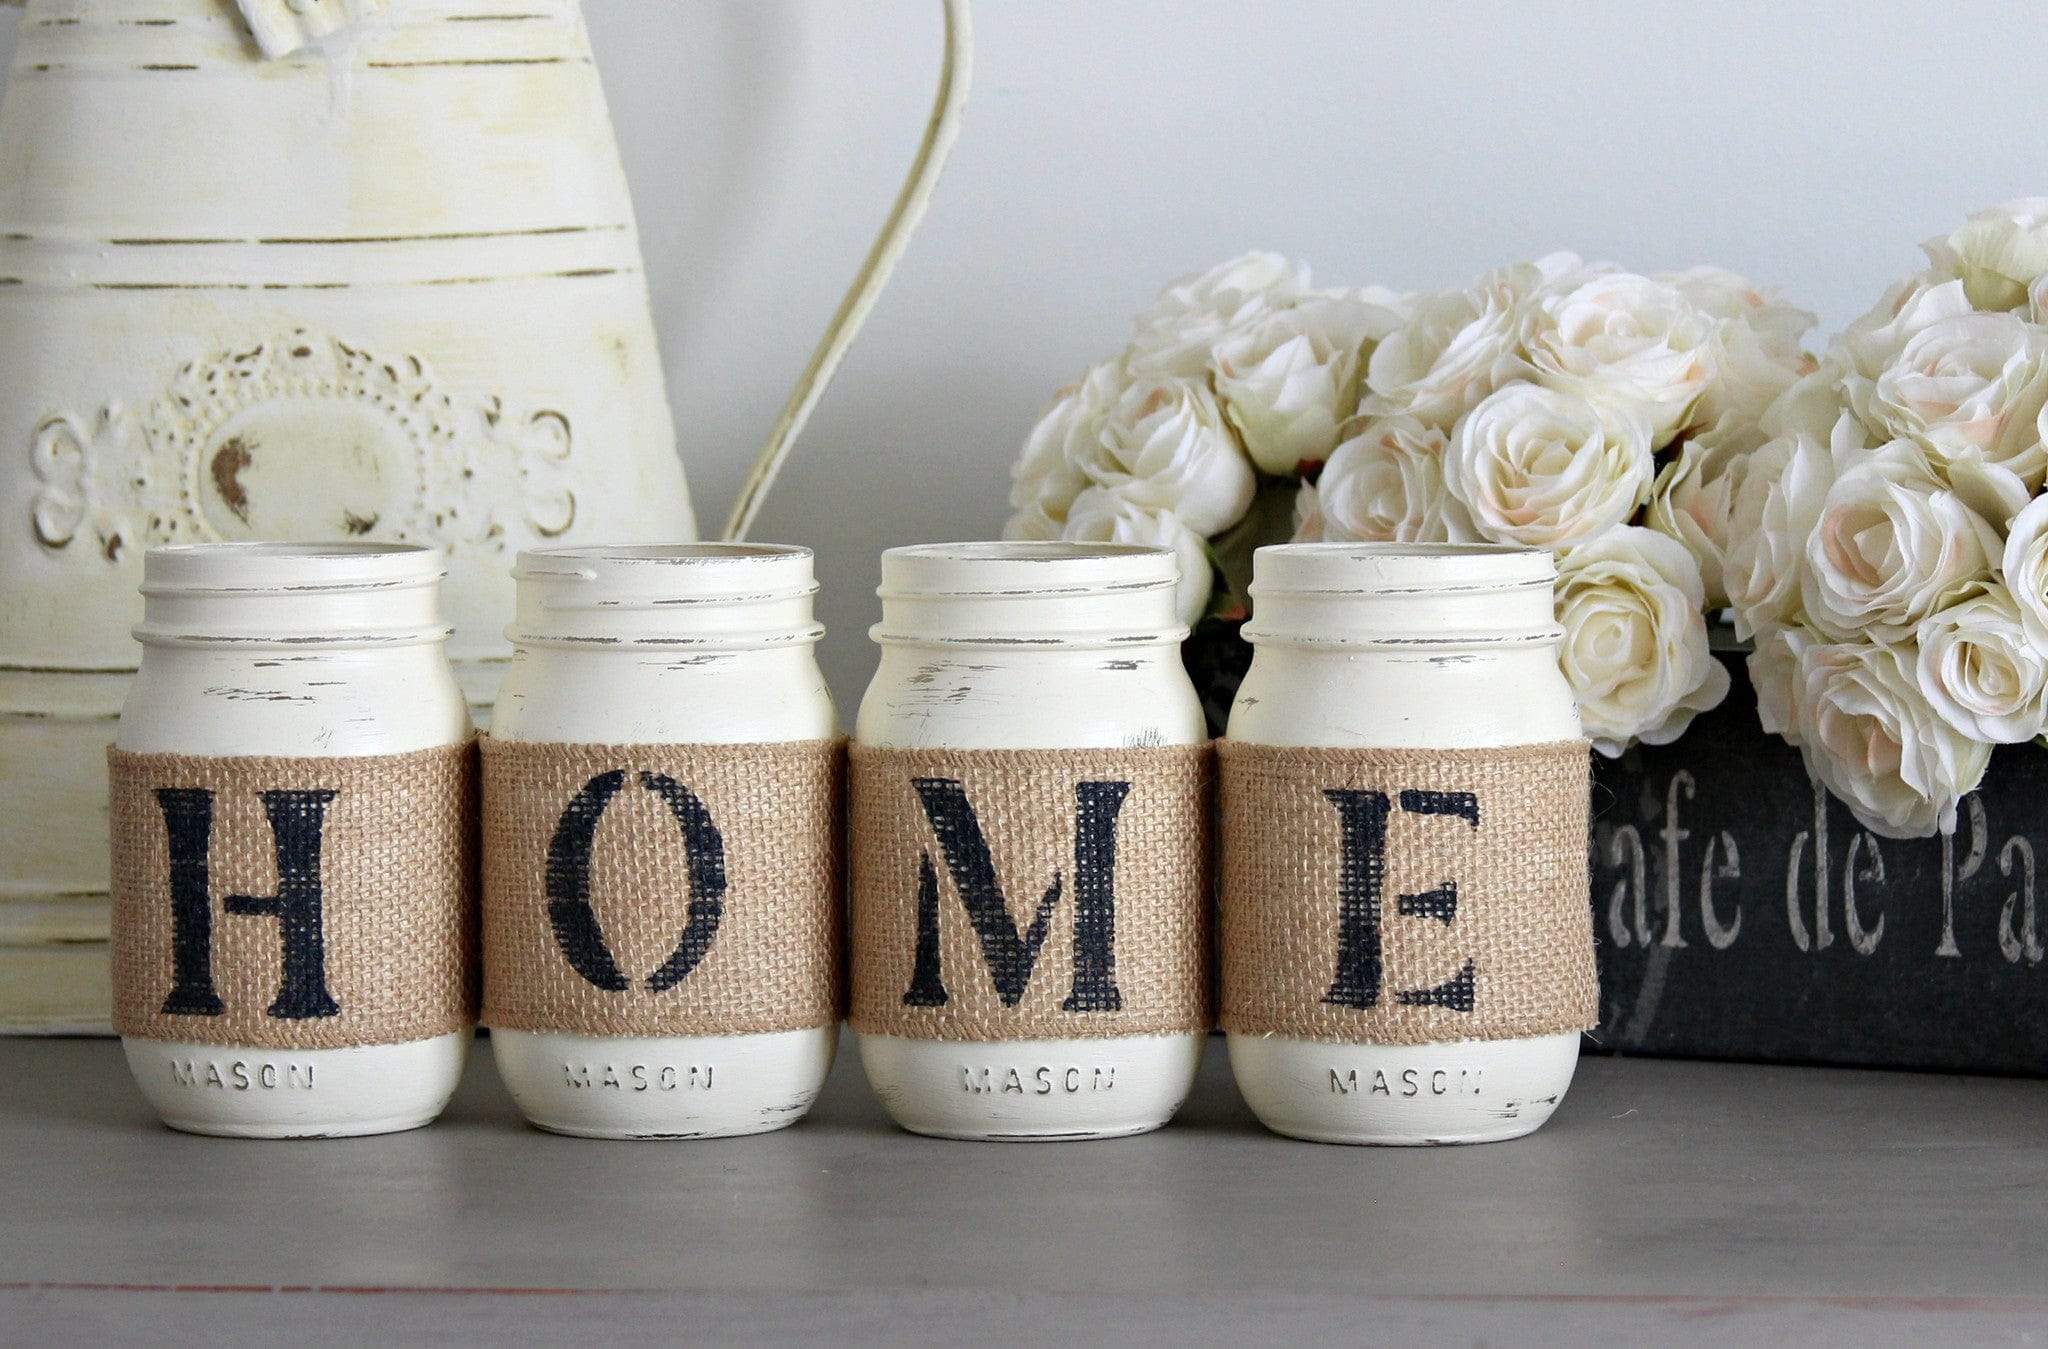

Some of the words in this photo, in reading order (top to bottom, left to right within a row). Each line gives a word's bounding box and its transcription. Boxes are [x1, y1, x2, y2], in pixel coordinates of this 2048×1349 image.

[1787, 782, 1886, 956] de
[171, 1059, 315, 1090] MASON
[563, 1064, 713, 1091] MASON
[962, 1065, 1115, 1094] MASON
